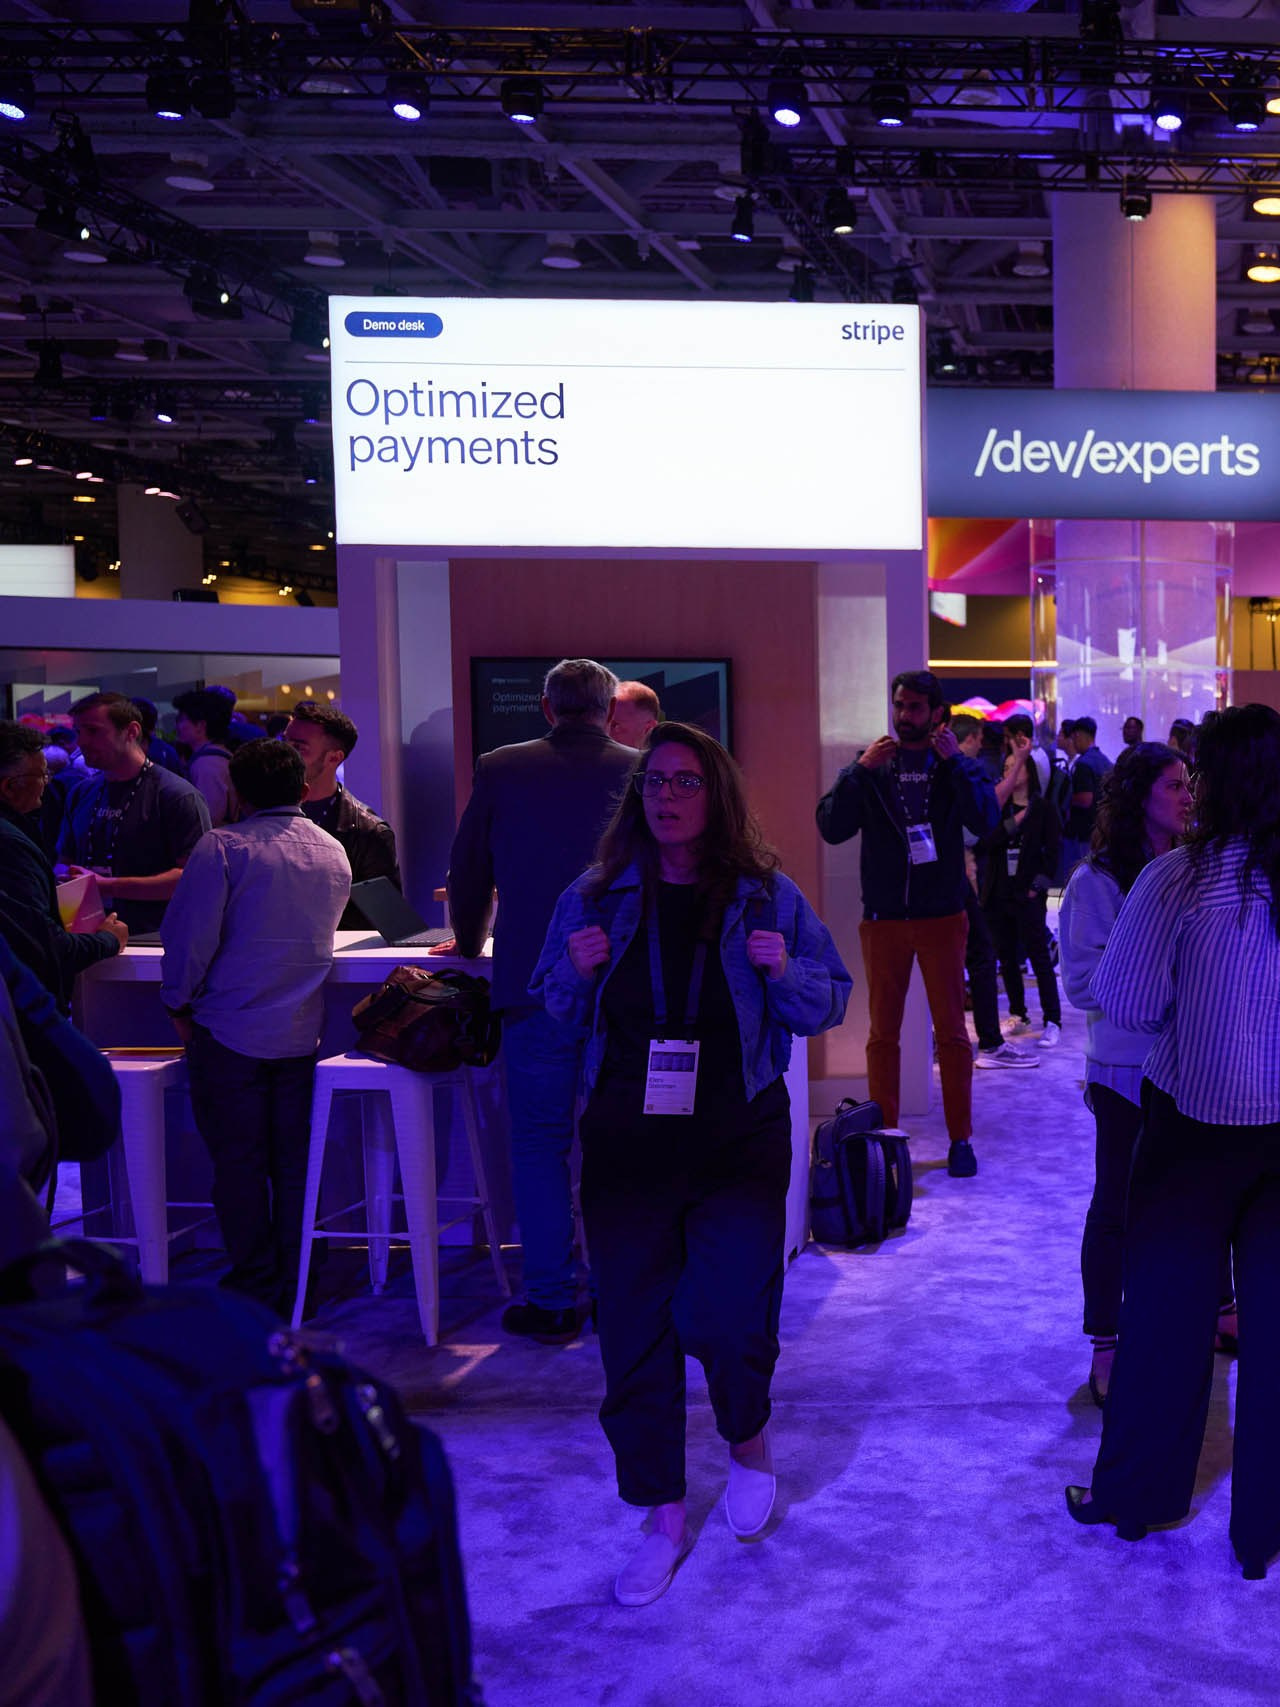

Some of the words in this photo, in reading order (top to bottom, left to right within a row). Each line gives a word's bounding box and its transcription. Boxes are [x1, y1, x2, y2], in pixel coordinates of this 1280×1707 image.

[363, 319, 396, 331] Demo
[397, 320, 425, 331] desk
[841, 319, 905, 345] stripe
[346, 378, 565, 425] Optimized
[349, 430, 559, 472] payments
[973, 428, 1260, 483] /dev/experts
[899, 771, 929, 784] stripe
